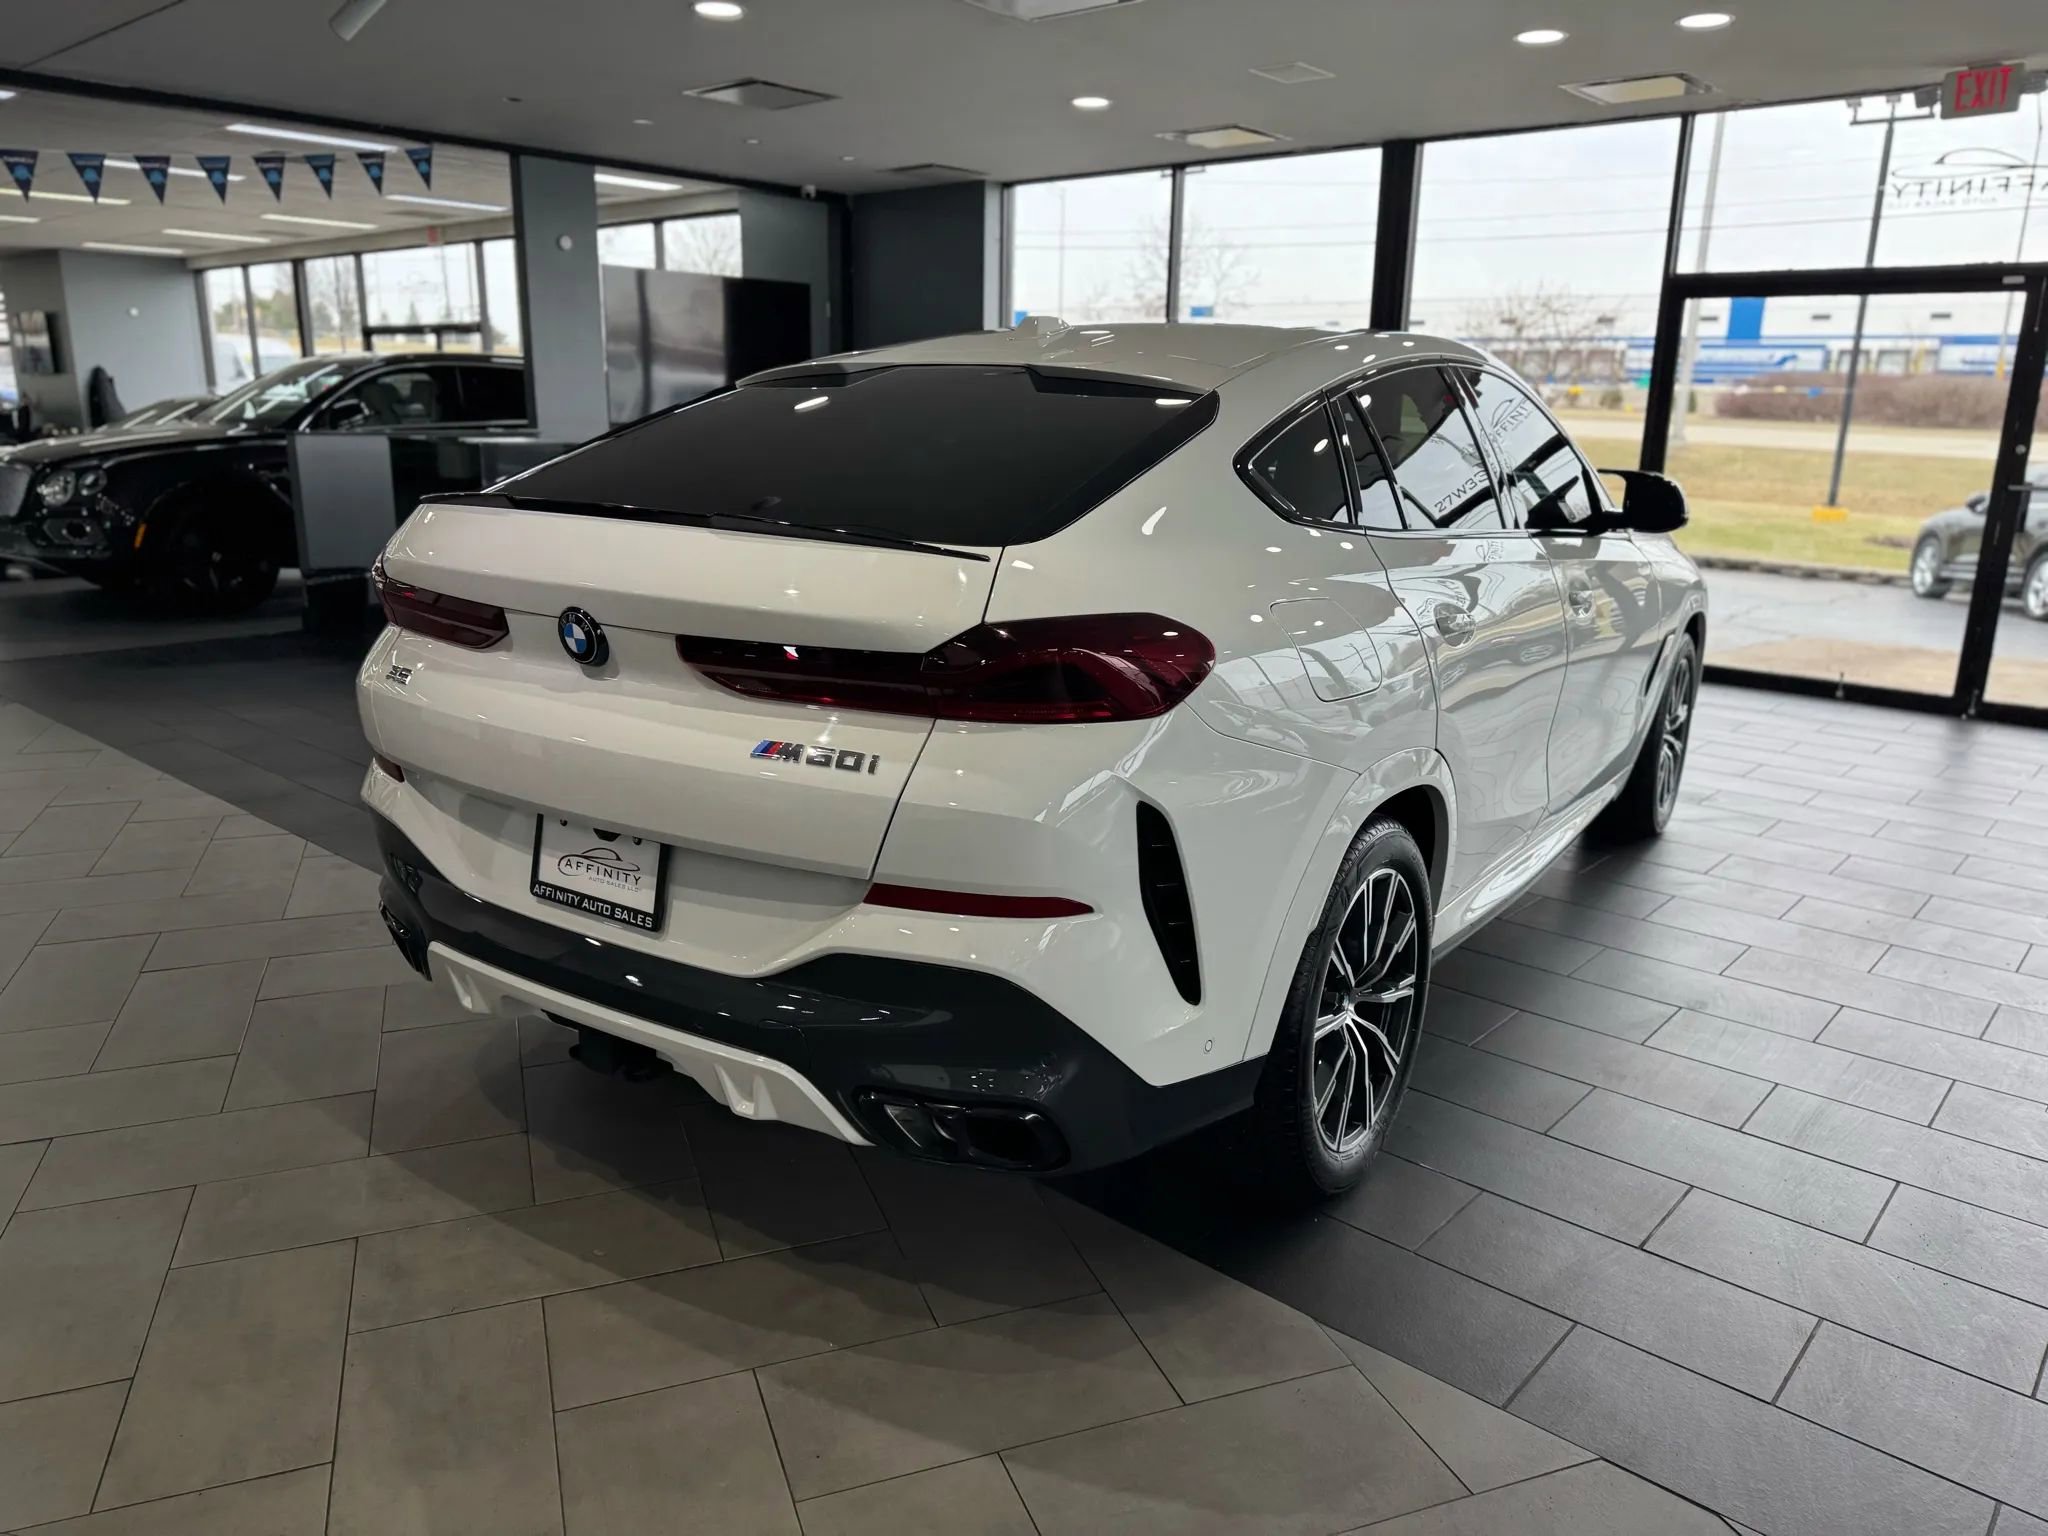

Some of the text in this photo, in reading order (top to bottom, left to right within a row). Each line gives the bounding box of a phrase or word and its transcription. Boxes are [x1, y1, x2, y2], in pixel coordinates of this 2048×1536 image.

[1953, 65, 2016, 113] EXIT
[564, 858, 642, 886] AFFINITY
[588, 875, 605, 885] AUTO
[532, 883, 654, 928] AFFINITY AUTO SALES
